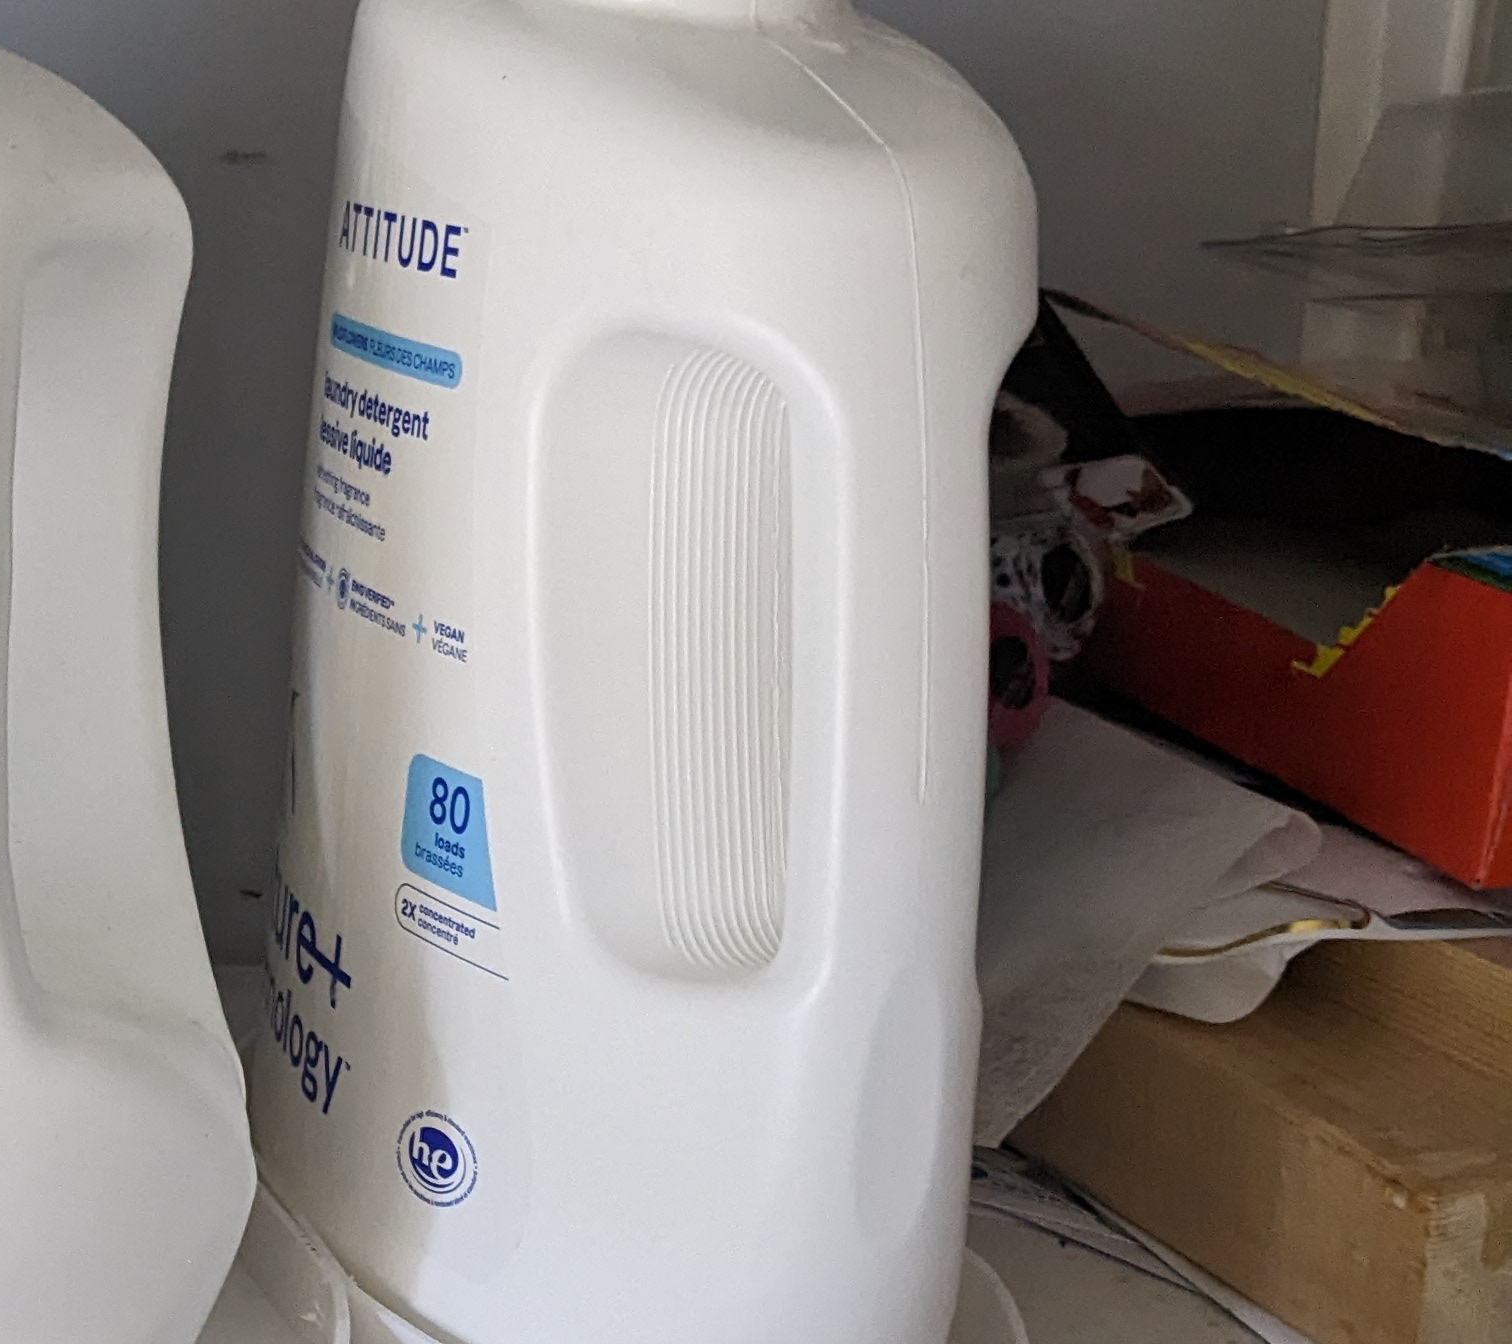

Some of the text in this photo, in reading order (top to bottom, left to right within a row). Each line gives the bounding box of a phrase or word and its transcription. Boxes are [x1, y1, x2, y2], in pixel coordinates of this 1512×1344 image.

[338, 199, 464, 279] ATTITUDE
[412, 353, 456, 380] CHAMPS
[358, 389, 430, 441] detergent
[349, 429, 393, 476] liquide
[431, 637, 469, 664] VÉGANE
[433, 620, 466, 644] VEGAN
[429, 776, 471, 835] 80
[414, 841, 465, 878] brassées
[434, 832, 466, 860] loads
[400, 897, 417, 923] 2X
[418, 902, 476, 940] concentrated
[416, 915, 460, 946] concentré
[411, 1129, 453, 1179] he
